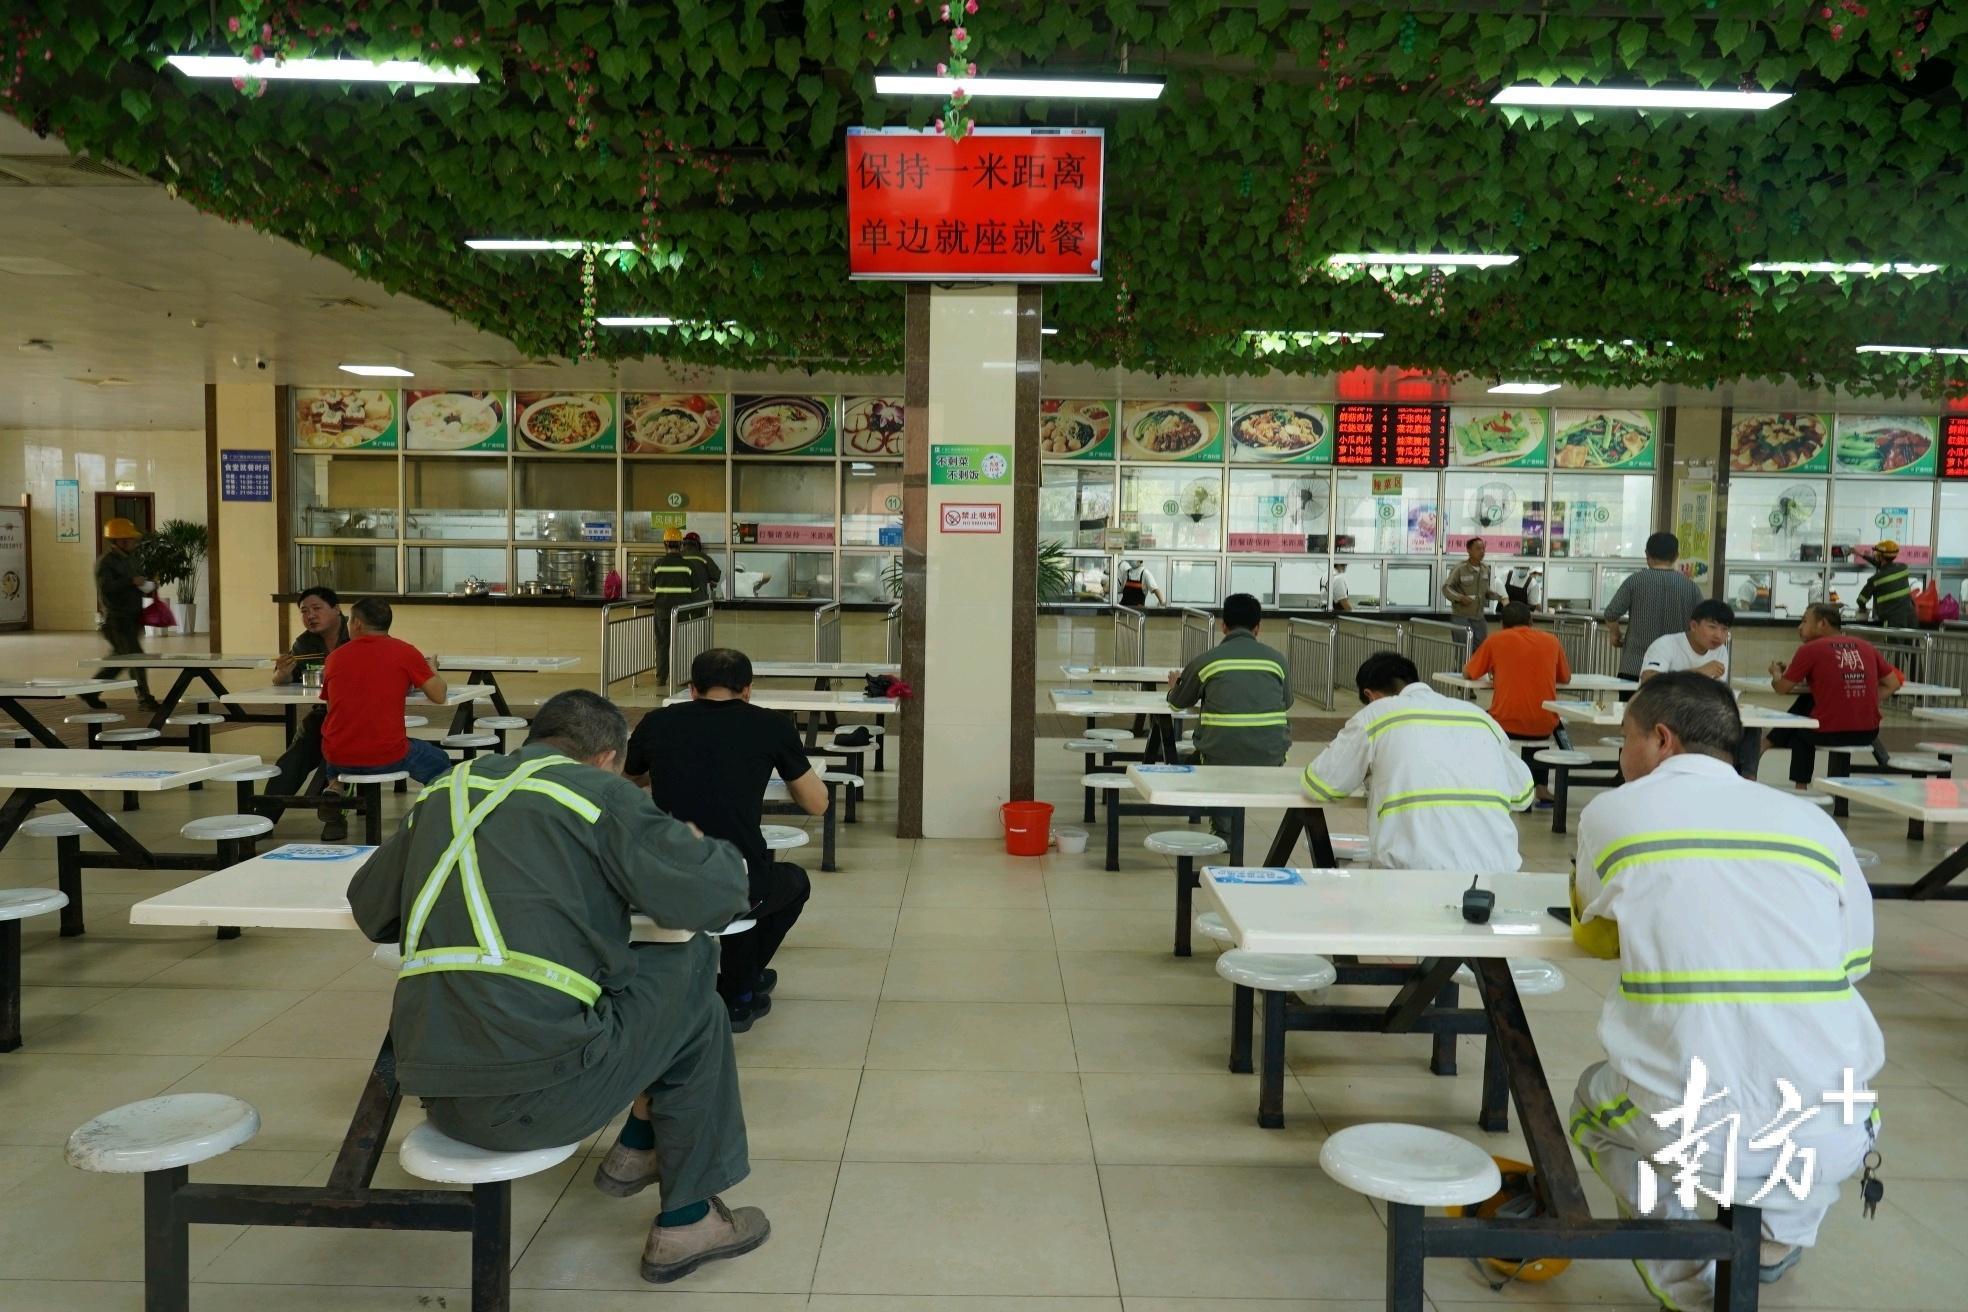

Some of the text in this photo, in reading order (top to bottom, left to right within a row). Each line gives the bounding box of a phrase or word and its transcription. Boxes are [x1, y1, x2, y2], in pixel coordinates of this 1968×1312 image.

[856, 152, 1086, 190] 保持一米距离
[858, 218, 1085, 255] 单边就座就餐
[1339, 435, 1372, 444] 小瓜肉片
[1338, 445, 1372, 455] 萝卜肉丝
[936, 456, 969, 467] 不剩菜
[225, 463, 270, 472] 食堂就餐时间
[947, 469, 980, 480] 不剩饭
[669, 495, 680, 505] 12
[888, 498, 897, 508] 11
[1166, 503, 1176, 513] 10
[1275, 504, 1282, 516] 9
[1383, 506, 1391, 517] 8
[1491, 508, 1498, 518] 7
[961, 511, 996, 520] 禁止吸烟
[1598, 511, 1605, 520] 6
[1772, 514, 1779, 524] 5
[1877, 516, 1886, 526] 4
[1835, 648, 1865, 671] 潮
